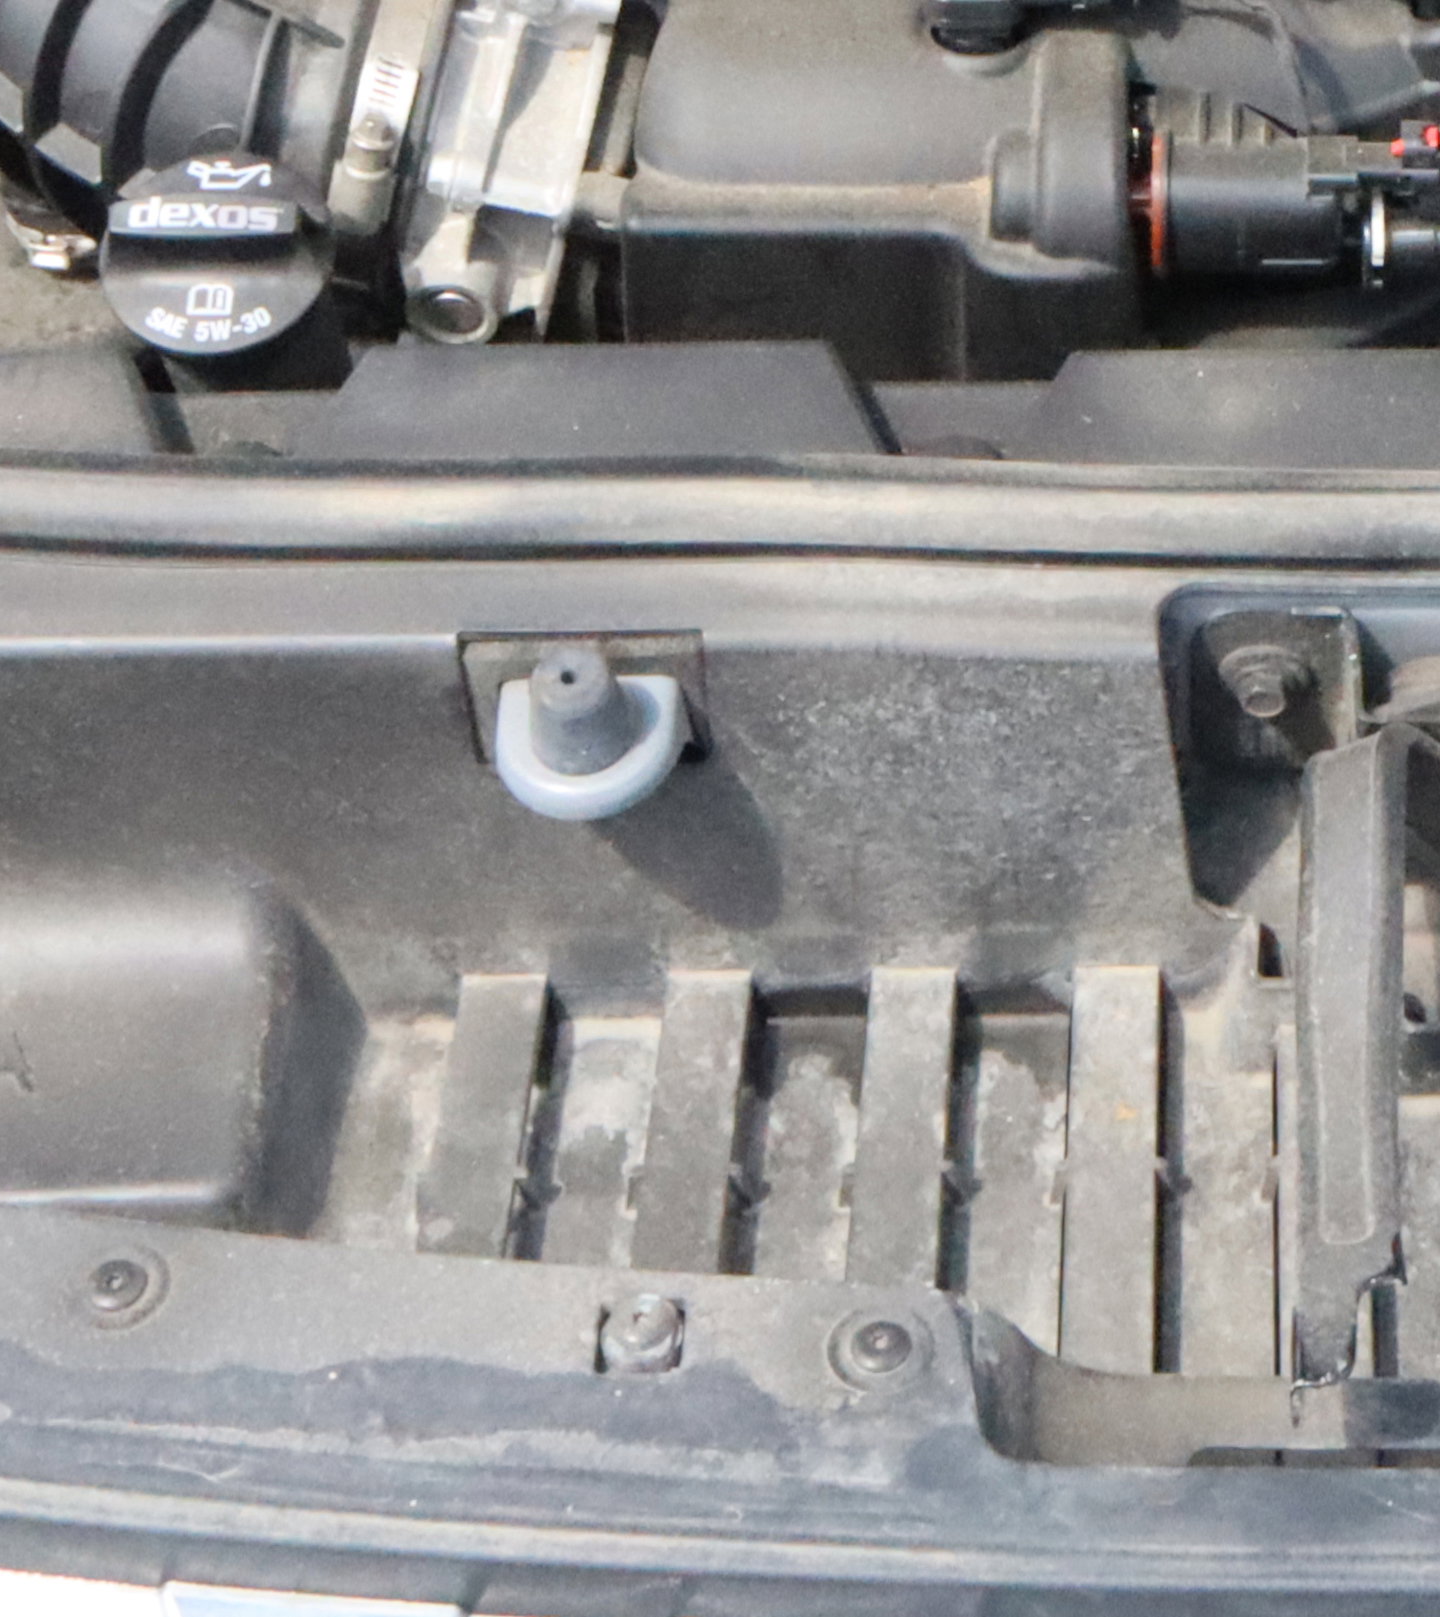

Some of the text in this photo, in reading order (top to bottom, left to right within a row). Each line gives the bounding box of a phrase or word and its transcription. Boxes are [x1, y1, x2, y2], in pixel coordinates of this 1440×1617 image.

[127, 195, 278, 232] dexos
[145, 306, 272, 342] SAE 5W-30
